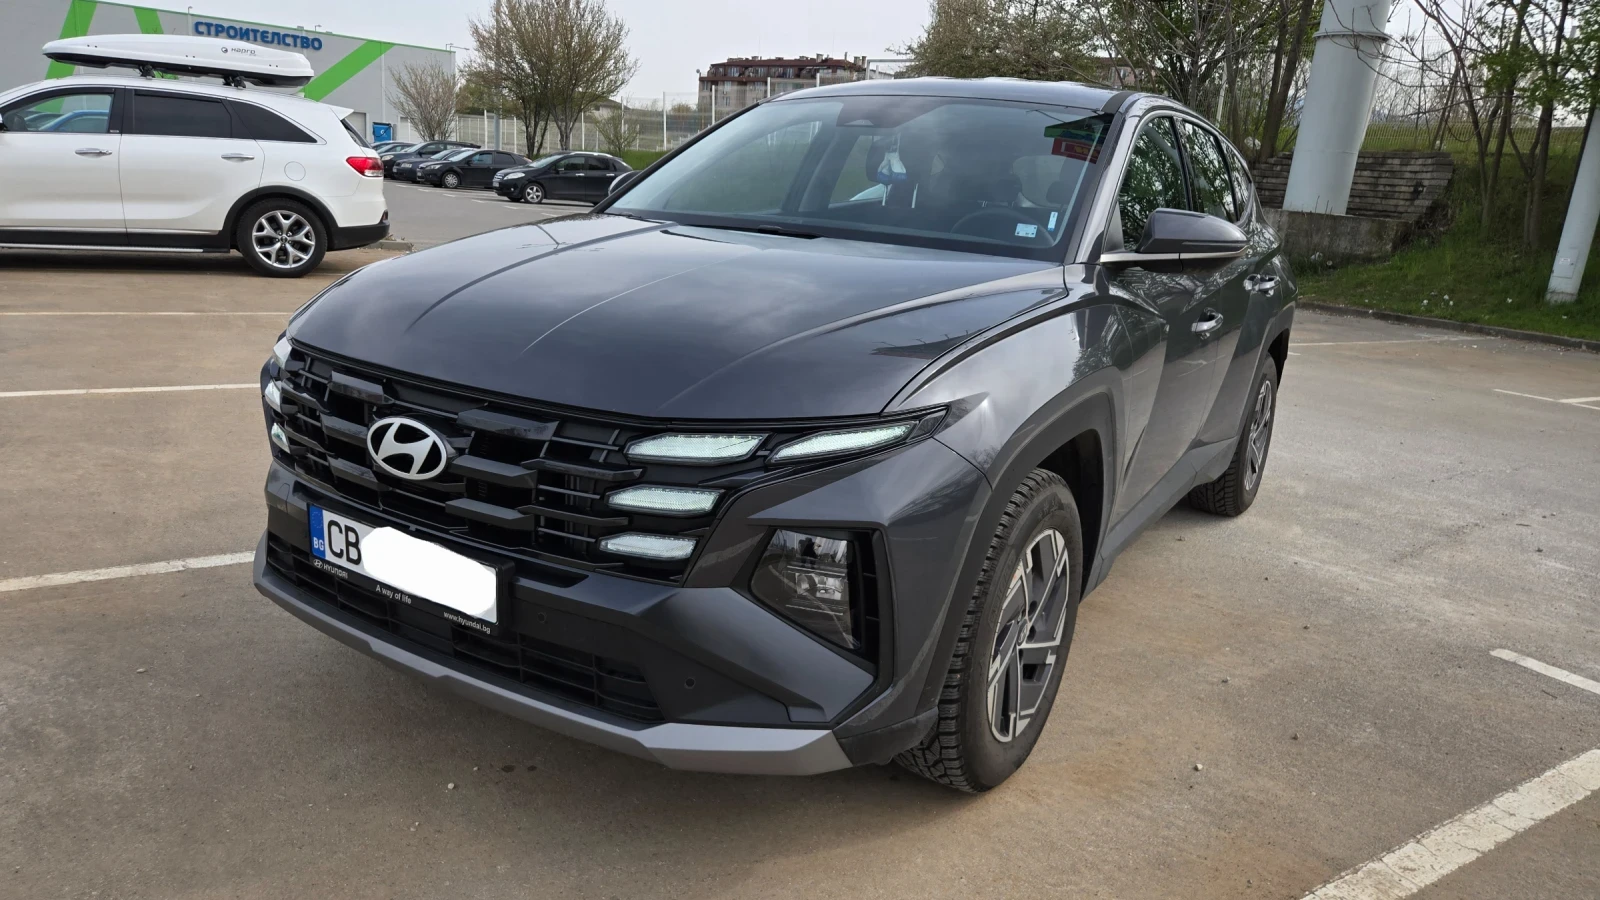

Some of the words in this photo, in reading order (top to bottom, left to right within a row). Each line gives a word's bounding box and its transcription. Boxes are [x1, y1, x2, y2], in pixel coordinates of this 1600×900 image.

[194, 21, 323, 51] СТРОИТЕЛСТВО
[313, 537, 324, 551] BG
[327, 519, 362, 566] CB
[323, 562, 349, 580] HYUNDAI
[375, 584, 381, 593] A
[381, 587, 394, 599] way
[394, 592, 401, 601] of
[401, 594, 412, 605] life
[443, 611, 491, 635] www.hyundai.bg
